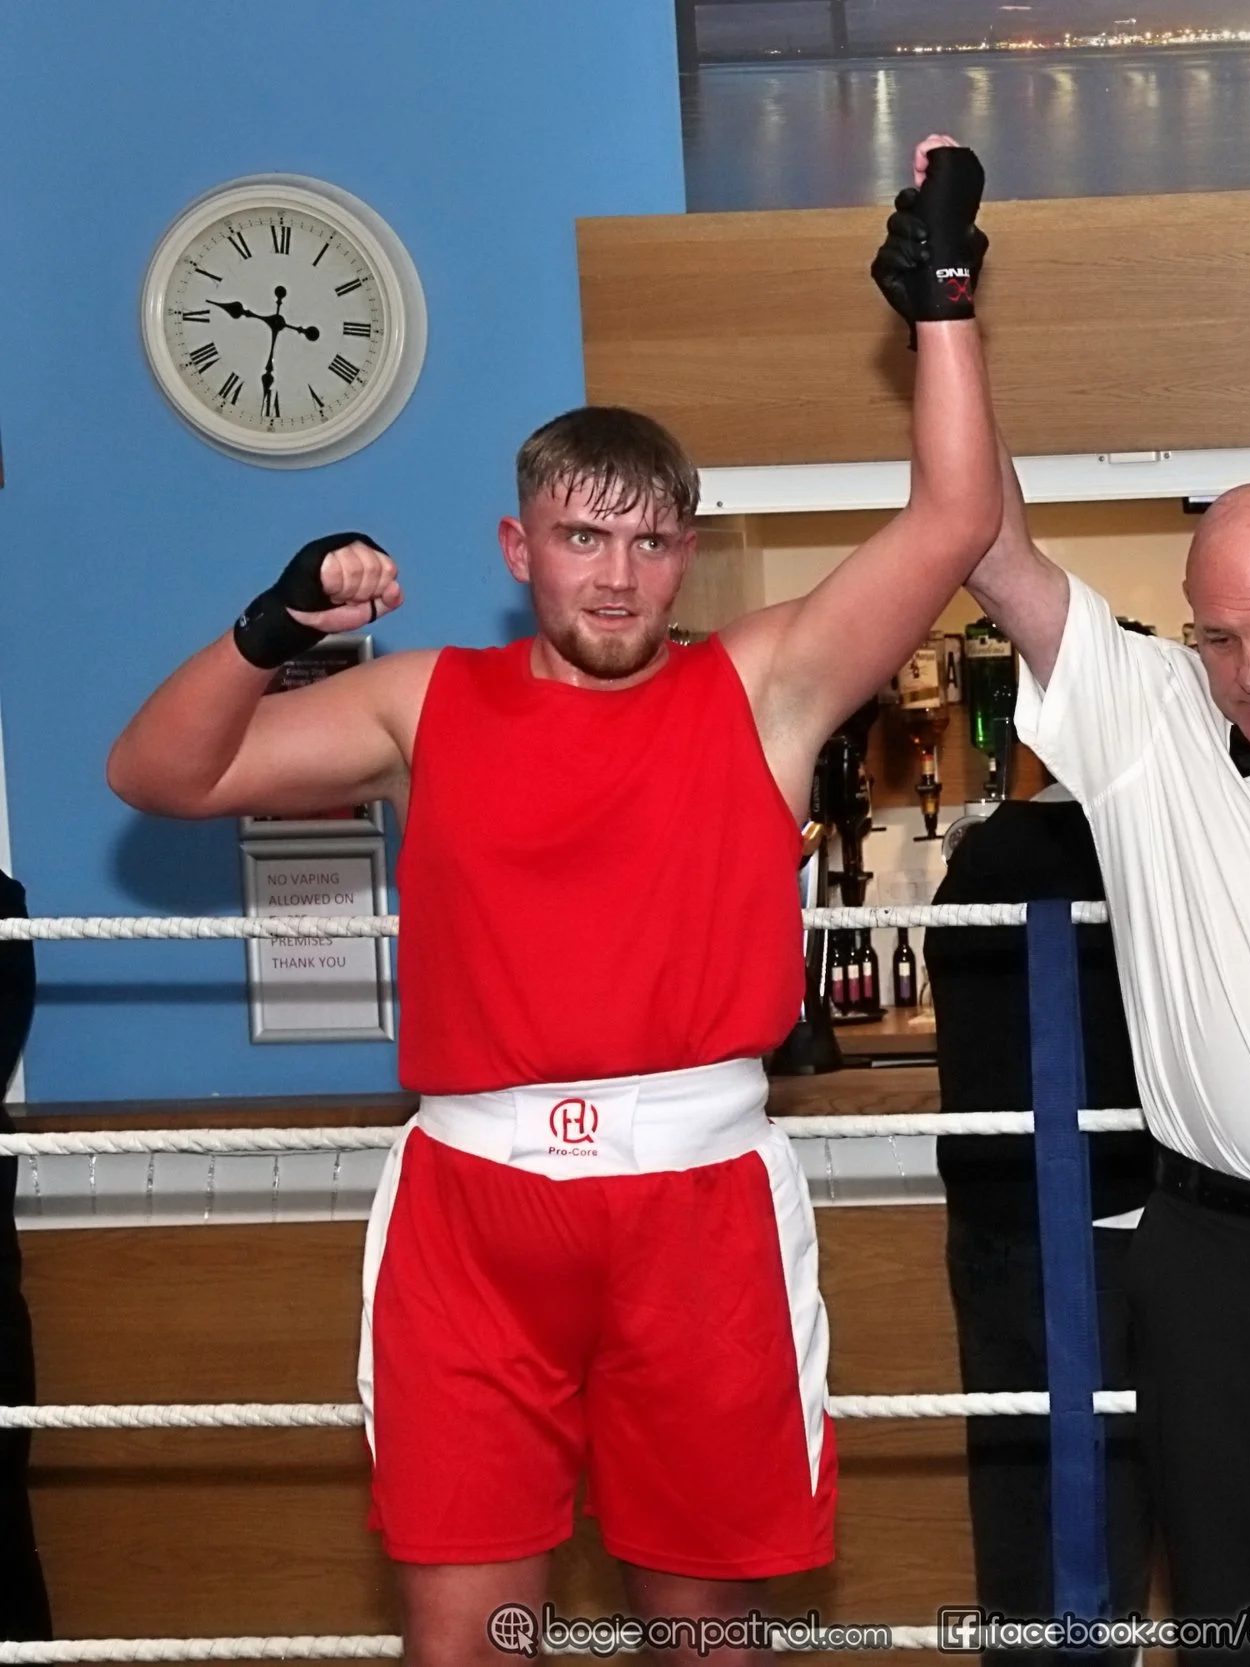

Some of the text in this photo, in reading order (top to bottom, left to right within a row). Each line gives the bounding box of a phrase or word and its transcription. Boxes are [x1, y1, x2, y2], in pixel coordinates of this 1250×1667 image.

[267, 872, 340, 886] NO VAPING
[268, 893, 354, 906] ALLOWED ON
[271, 936, 333, 947] PREMISES
[272, 956, 346, 969] THANK YOU
[548, 1146, 598, 1156] Pro-Core
